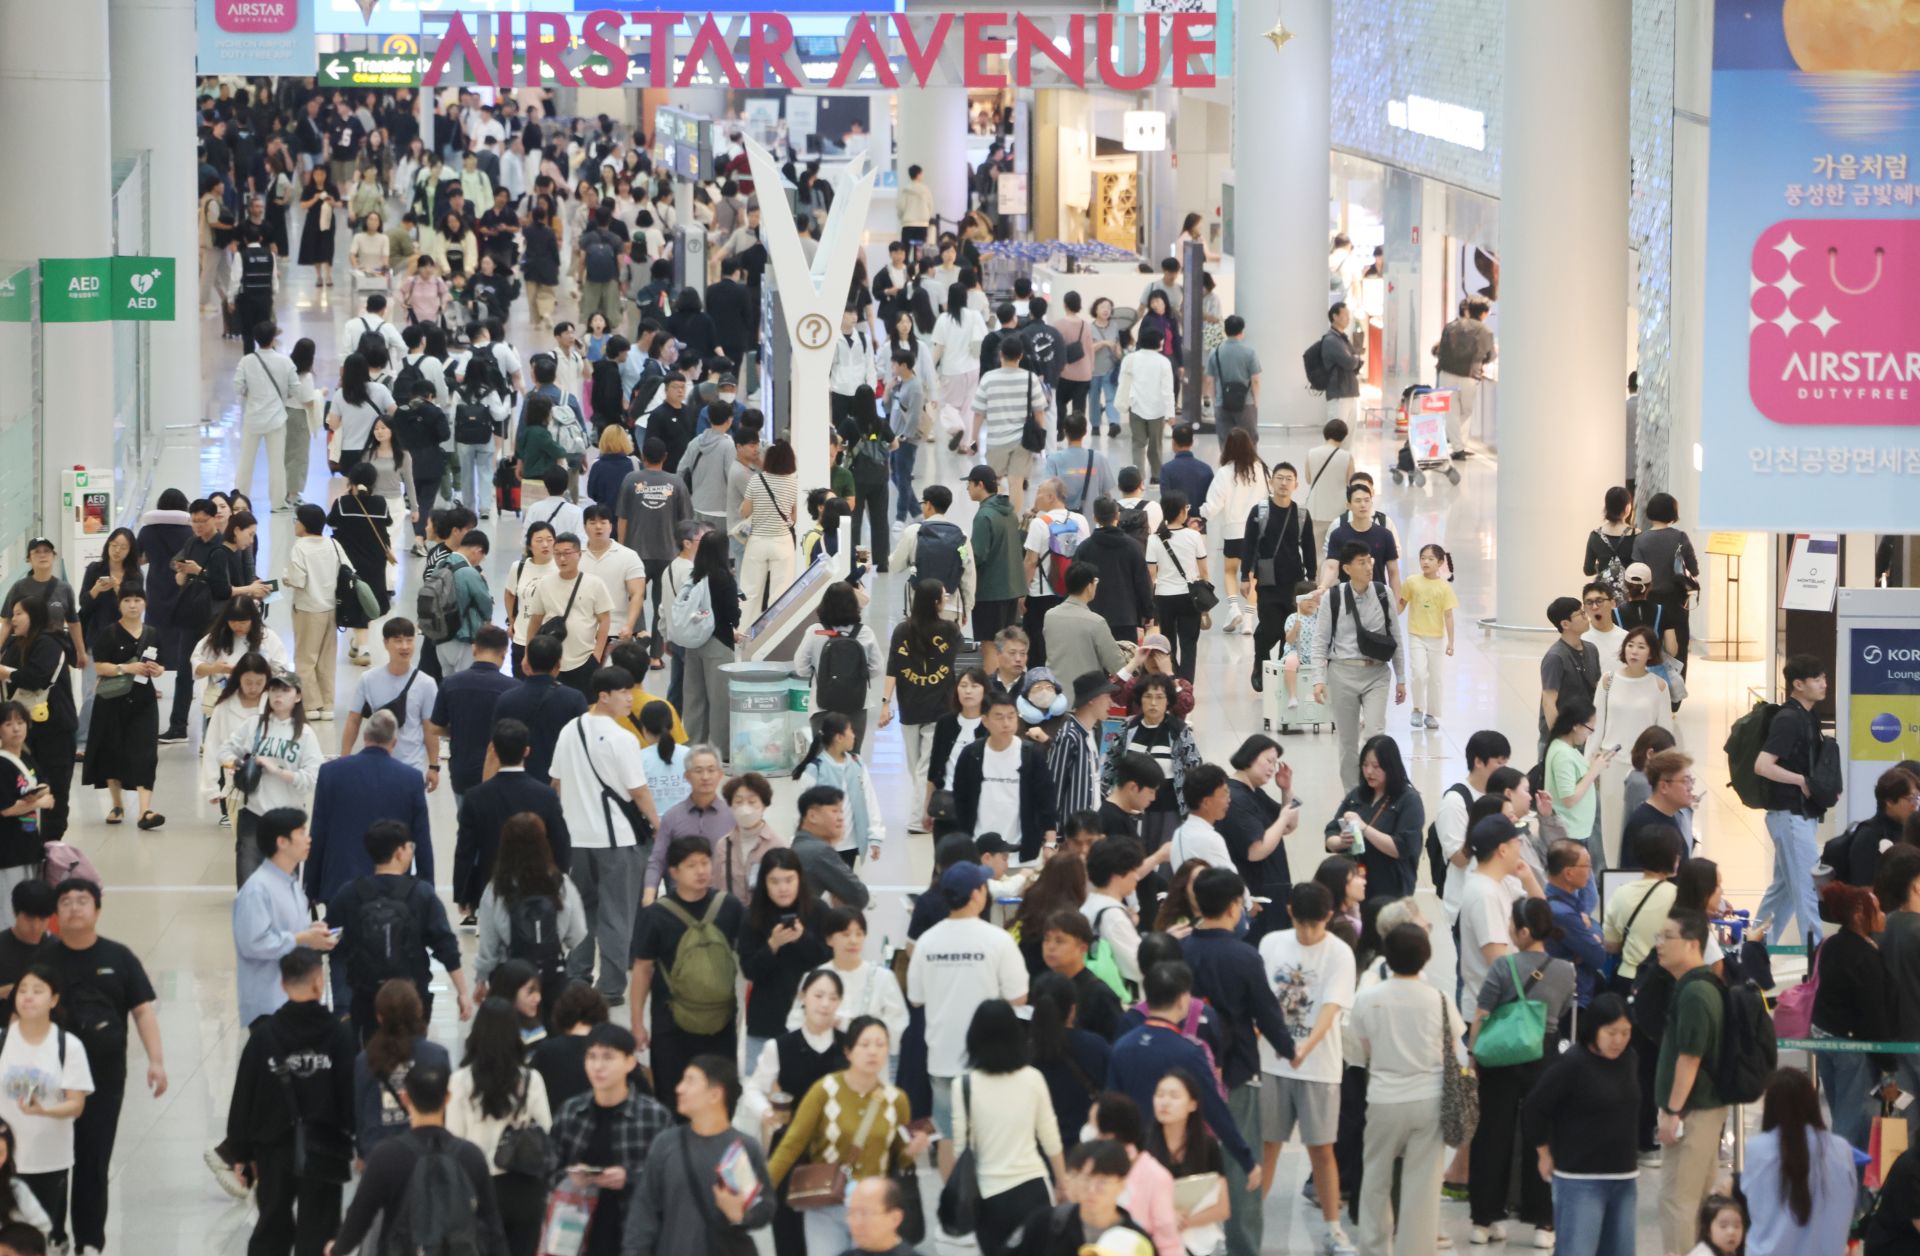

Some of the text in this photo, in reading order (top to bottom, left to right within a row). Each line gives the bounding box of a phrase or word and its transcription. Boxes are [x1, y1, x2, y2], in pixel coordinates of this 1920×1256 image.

[227, 4, 284, 16] AIRSTAR
[420, 9, 1217, 90] AIRSTAR AVENUE
[352, 57, 415, 74] Transfer
[1811, 153, 1908, 181] 가을처럼
[1784, 183, 1920, 207] 풍성한 금빛혜
[68, 276, 100, 291] AED
[127, 298, 158, 309] AED
[1781, 351, 1920, 383] AIRSTAR
[1797, 388, 1909, 400] DUTYFREE
[87, 494, 106, 504] AED
[900, 664, 949, 686] ARTOIS
[926, 953, 985, 962] UMBRO
[1839, 1041, 1873, 1051] COFFEE
